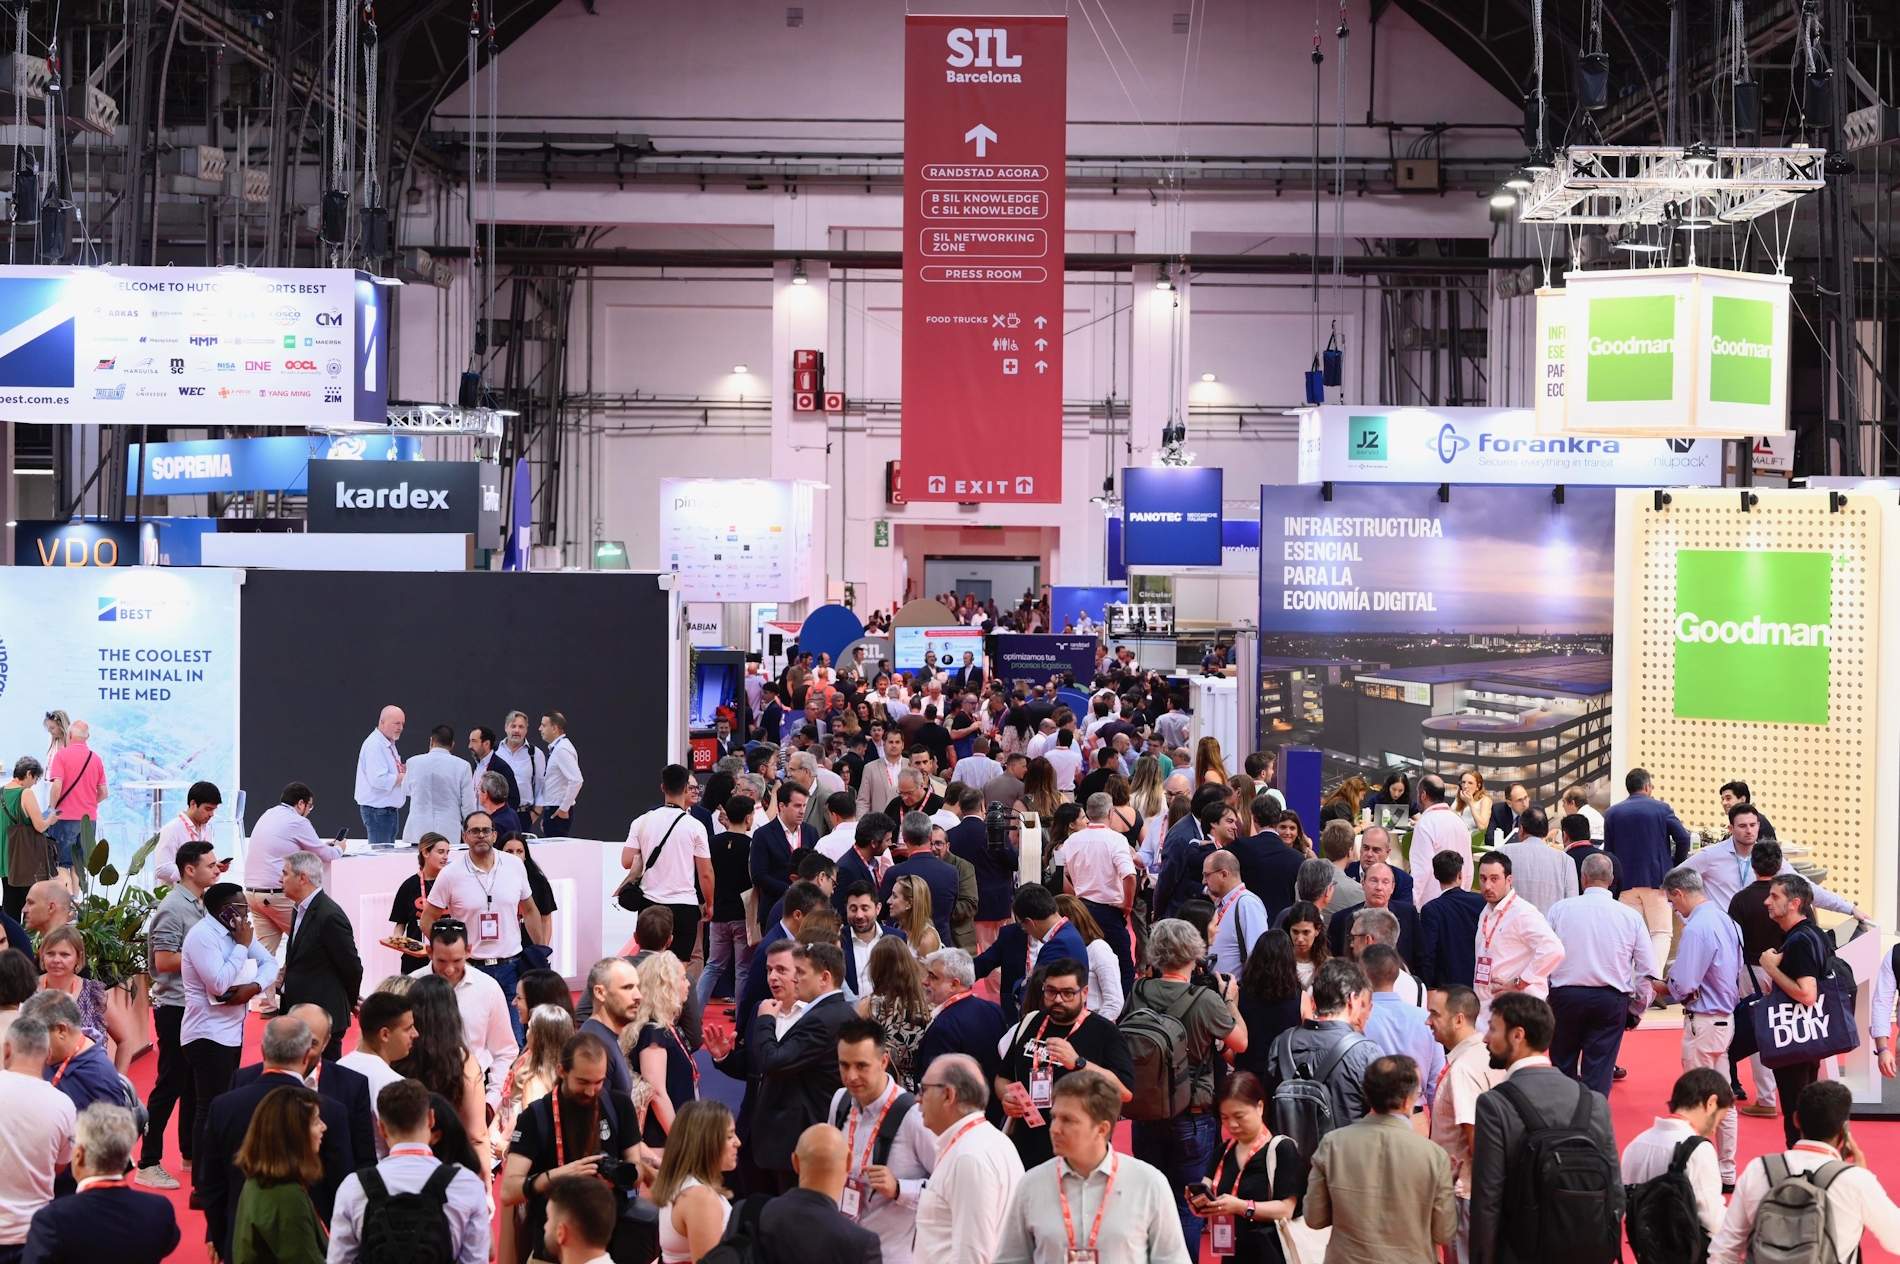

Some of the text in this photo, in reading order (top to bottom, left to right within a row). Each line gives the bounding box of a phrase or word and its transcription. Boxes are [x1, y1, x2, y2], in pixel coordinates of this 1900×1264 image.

[946, 27, 1022, 68] SIL
[946, 70, 1022, 84] Barcelona
[930, 168, 1039, 178] RANDSTAD AGORA
[932, 194, 1039, 204] B SIL KNOWLEDGE
[931, 206, 1039, 215] C SIL KNOWLEDGE
[933, 233, 1035, 243] SIL NETWORKING
[933, 242, 966, 252] ZONE
[945, 269, 1022, 279] PRESS ROOM
[114, 281, 165, 292] ELCOME
[168, 282, 184, 292] TO
[299, 285, 327, 294] BEST
[926, 315, 989, 324] FOOD TRUCKS
[189, 336, 218, 347] HMM
[1588, 336, 1675, 356] Goodman
[1711, 335, 1773, 358] Goodman
[245, 361, 272, 371] ONE
[284, 360, 317, 370] OOCL
[178, 386, 206, 396] WEC
[324, 395, 342, 403] ZIM
[1479, 433, 1620, 453] forankra
[152, 453, 233, 481] SOPREMA
[955, 480, 1009, 495] EXIT
[335, 481, 450, 510] kardex
[1129, 511, 1183, 522] PANOTEC
[1284, 516, 1443, 538] INFRAESTRUCTURA
[37, 537, 119, 567] VDO
[1284, 541, 1363, 562] ESENCIAL
[1283, 565, 1353, 586] PARA LA
[1138, 591, 1173, 599] Circular
[1283, 586, 1437, 612] ECONOMÍA DIGITAL
[120, 608, 153, 620] BEST
[1675, 612, 1833, 648] Goodman
[98, 648, 212, 663] THE COOLEST
[98, 668, 203, 682] TERMINAL IN
[98, 687, 171, 701] THE MED
[1773, 1014, 1830, 1048] DUTY
